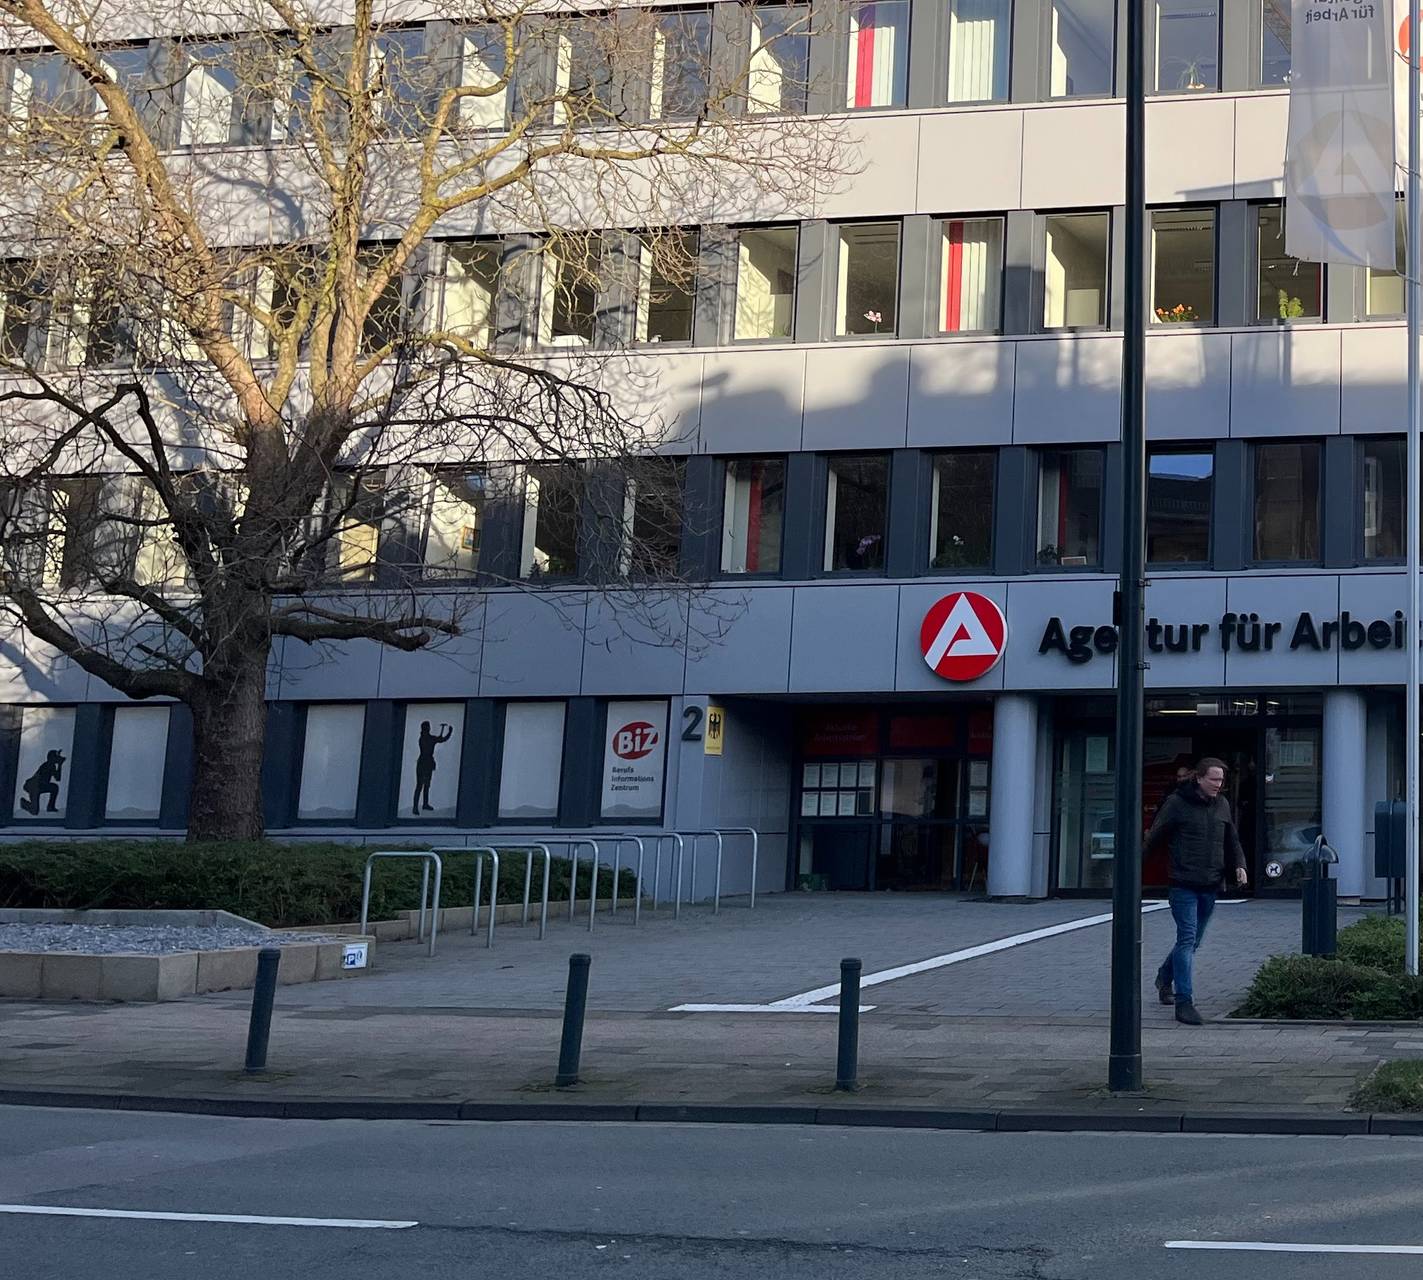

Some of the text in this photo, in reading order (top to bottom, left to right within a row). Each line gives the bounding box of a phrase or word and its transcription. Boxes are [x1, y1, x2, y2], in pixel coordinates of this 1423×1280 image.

[1039, 610, 1423, 664] Agetur für Arbei
[618, 727, 659, 754] BiZ
[681, 705, 703, 741] 2
